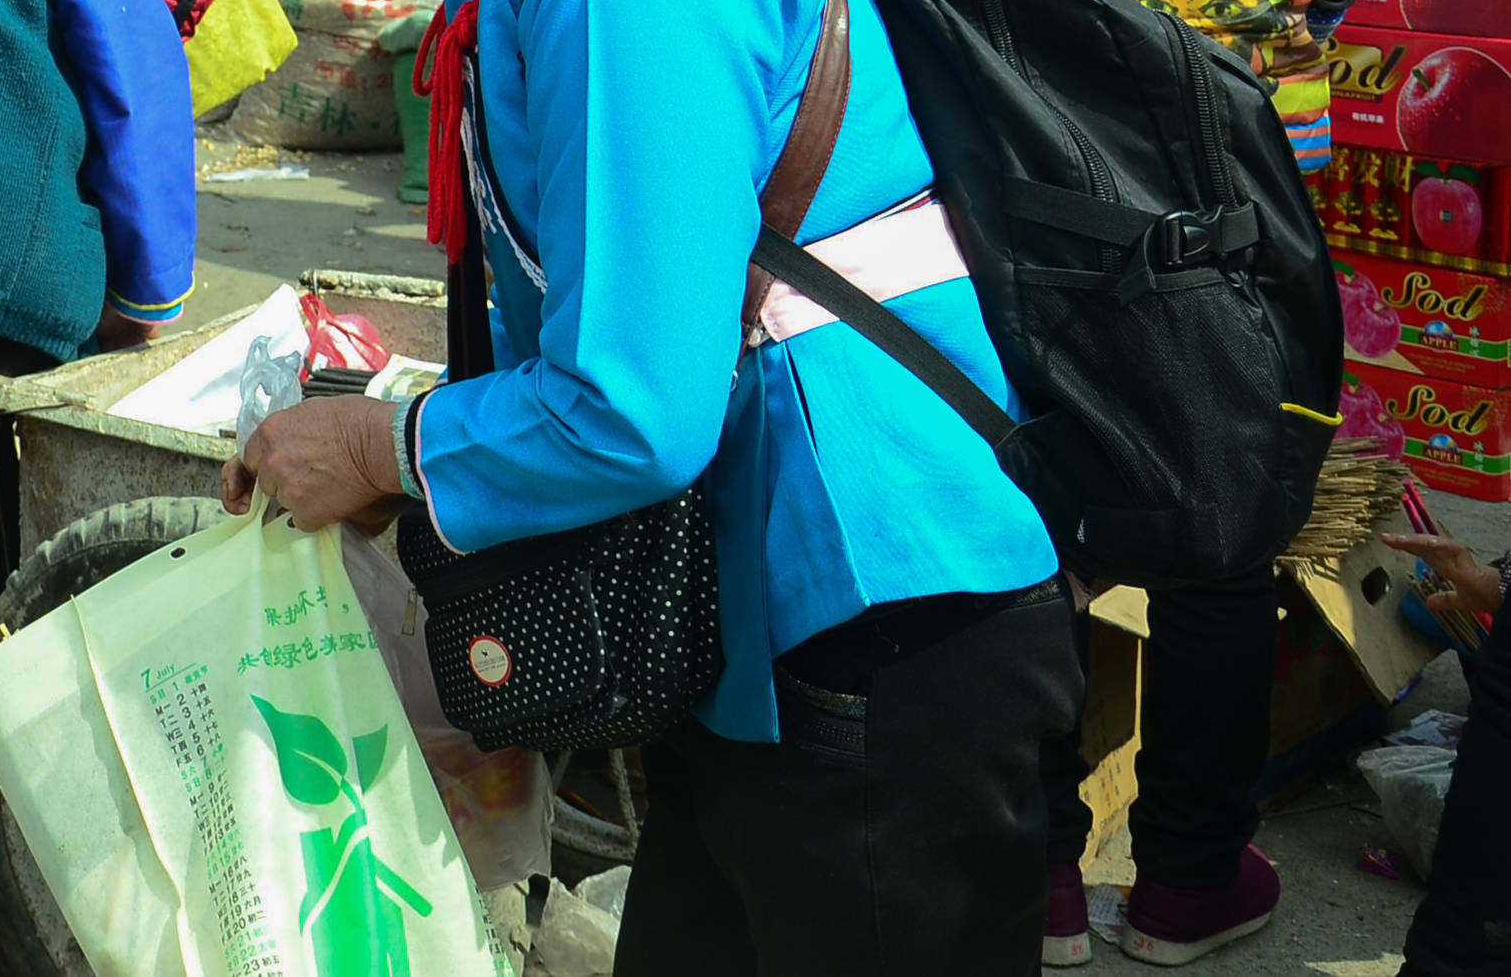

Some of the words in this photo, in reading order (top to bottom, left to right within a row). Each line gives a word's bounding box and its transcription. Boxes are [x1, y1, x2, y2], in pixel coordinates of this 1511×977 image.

[1328, 37, 1408, 94] od
[1381, 271, 1488, 321] Sod
[1421, 335, 1457, 350] APPLE
[1386, 384, 1493, 436] Sod
[1425, 448, 1461, 464] APPLE
[155, 664, 176, 680] July
[176, 693, 187, 706] 2
[182, 706, 192, 719] 3
[188, 719, 196, 730] 4
[192, 732, 201, 744] 5
[196, 744, 205, 756] 6
[222, 865, 233, 882] 16
[230, 904, 242, 921] 19
[232, 917, 246, 935] 20
[242, 959, 260, 976] 23
